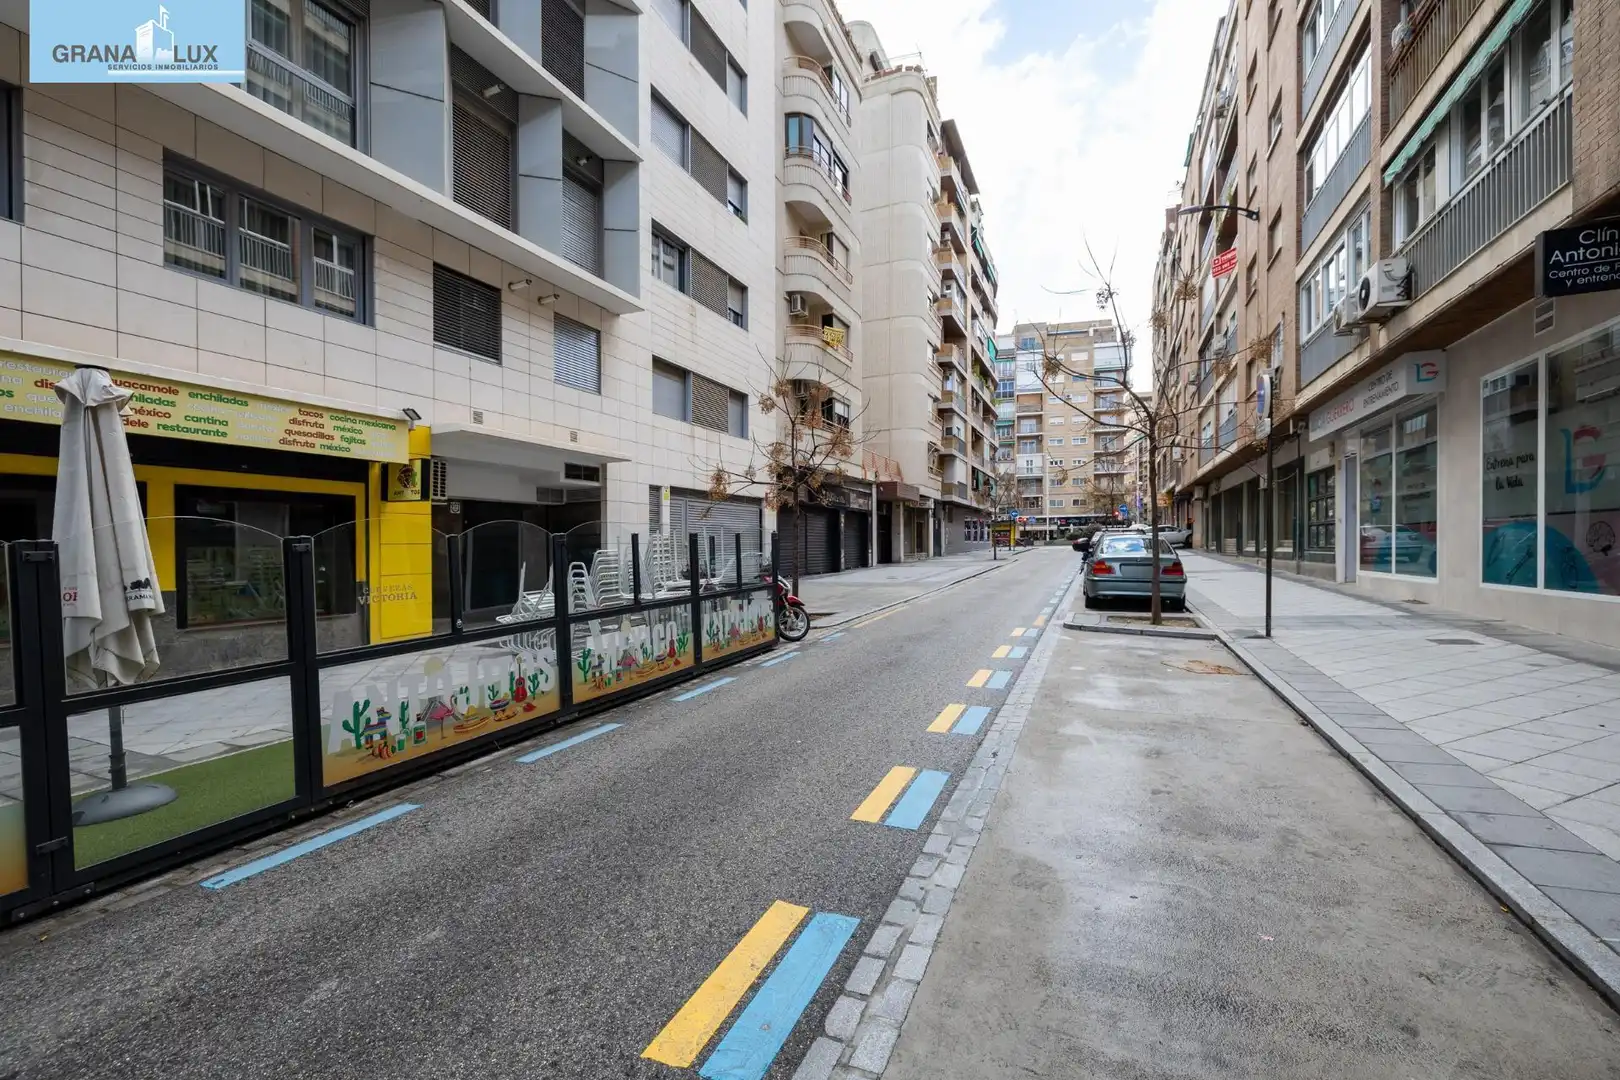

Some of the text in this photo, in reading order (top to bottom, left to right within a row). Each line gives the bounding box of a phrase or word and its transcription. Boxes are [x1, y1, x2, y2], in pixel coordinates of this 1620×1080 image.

[1549, 242, 1620, 265] Antoni
[1549, 267, 1590, 279] Centro
[1594, 264, 1610, 273] de
[188, 390, 249, 407] enchiladas
[298, 408, 324, 419] tacos
[329, 413, 357, 425] cocina
[358, 419, 397, 432] mexicana
[156, 421, 228, 438] restaurante
[279, 436, 316, 449] disfruta
[319, 442, 351, 453] méxico
[184, 414, 229, 427] cantina
[284, 427, 335, 442] quesadillas
[340, 434, 366, 446] fajitas
[289, 417, 325, 430] disfruta
[333, 423, 363, 435] méxico
[357, 591, 418, 605] VICTORIA
